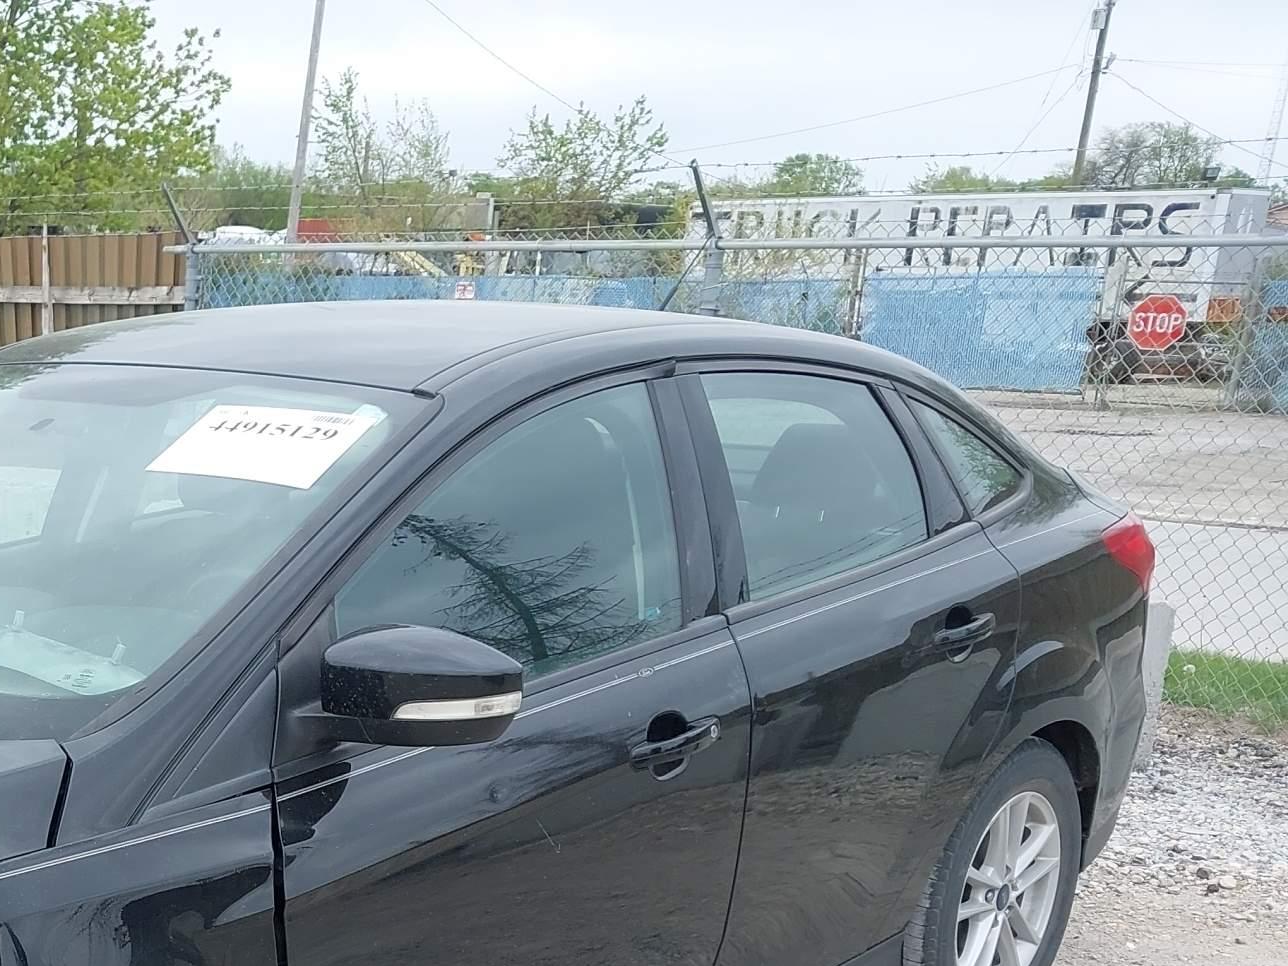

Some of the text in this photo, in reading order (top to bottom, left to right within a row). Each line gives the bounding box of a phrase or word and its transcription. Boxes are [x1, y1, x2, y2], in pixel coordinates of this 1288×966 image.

[691, 207, 881, 266] TRUCK
[1133, 311, 1183, 334] STOP
[209, 420, 339, 441] 44915129
